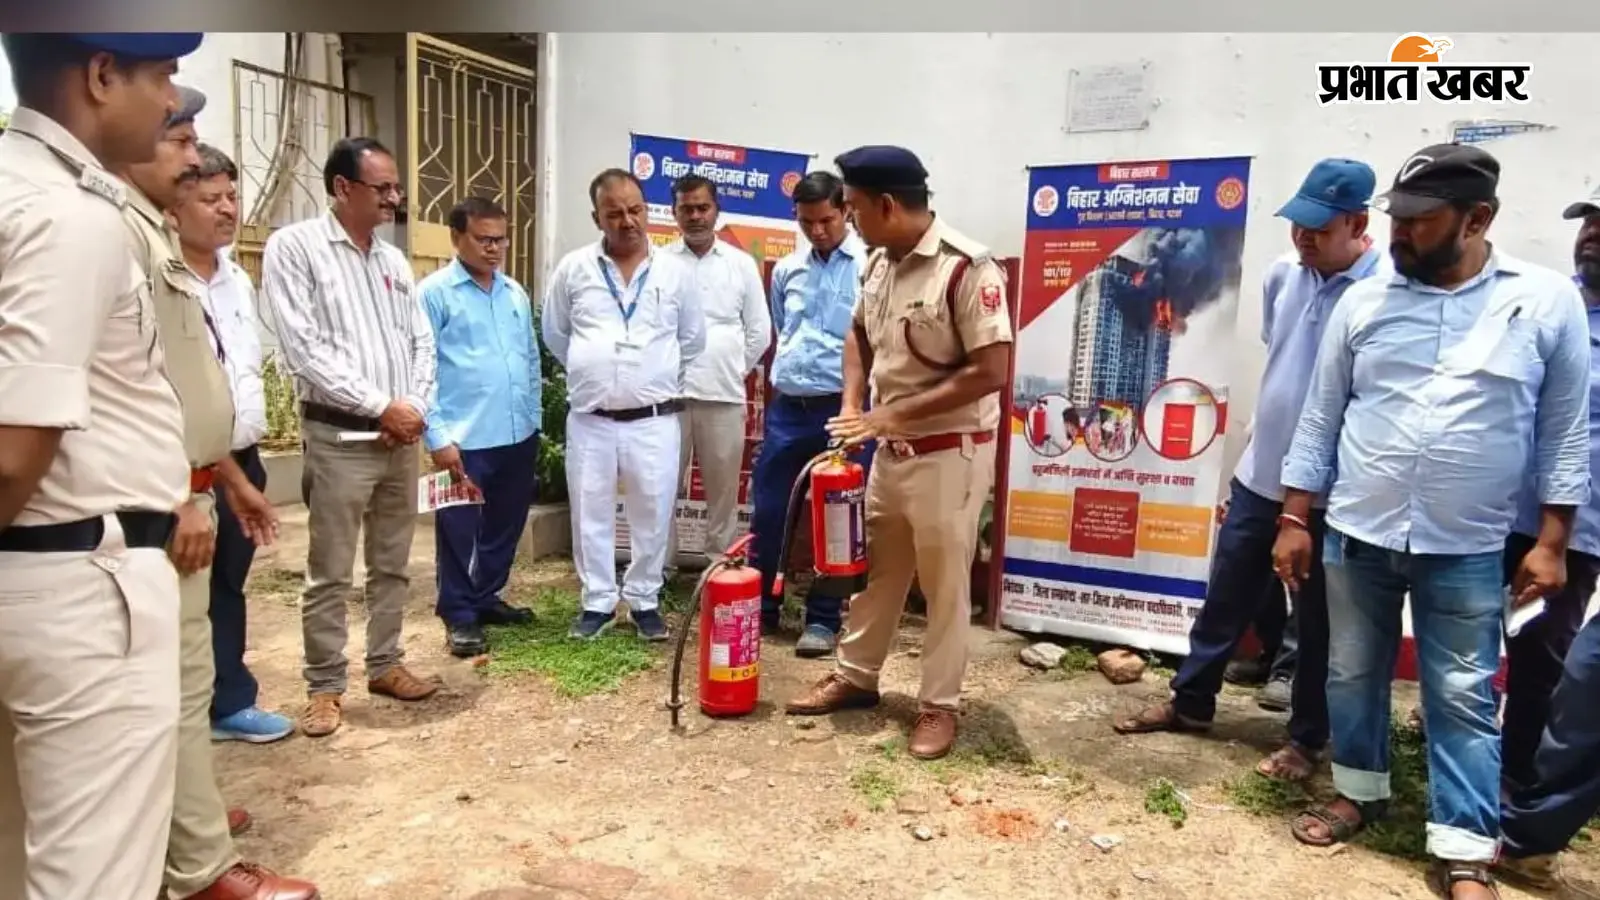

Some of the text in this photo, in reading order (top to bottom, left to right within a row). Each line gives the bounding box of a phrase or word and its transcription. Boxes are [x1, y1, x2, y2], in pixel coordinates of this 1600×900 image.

[661, 156, 690, 178] बिहार
[747, 167, 770, 189] सेवा
[1109, 165, 1160, 179] बिहार सरकार
[1066, 181, 1201, 209] बिहार अग्निशमन सेवा
